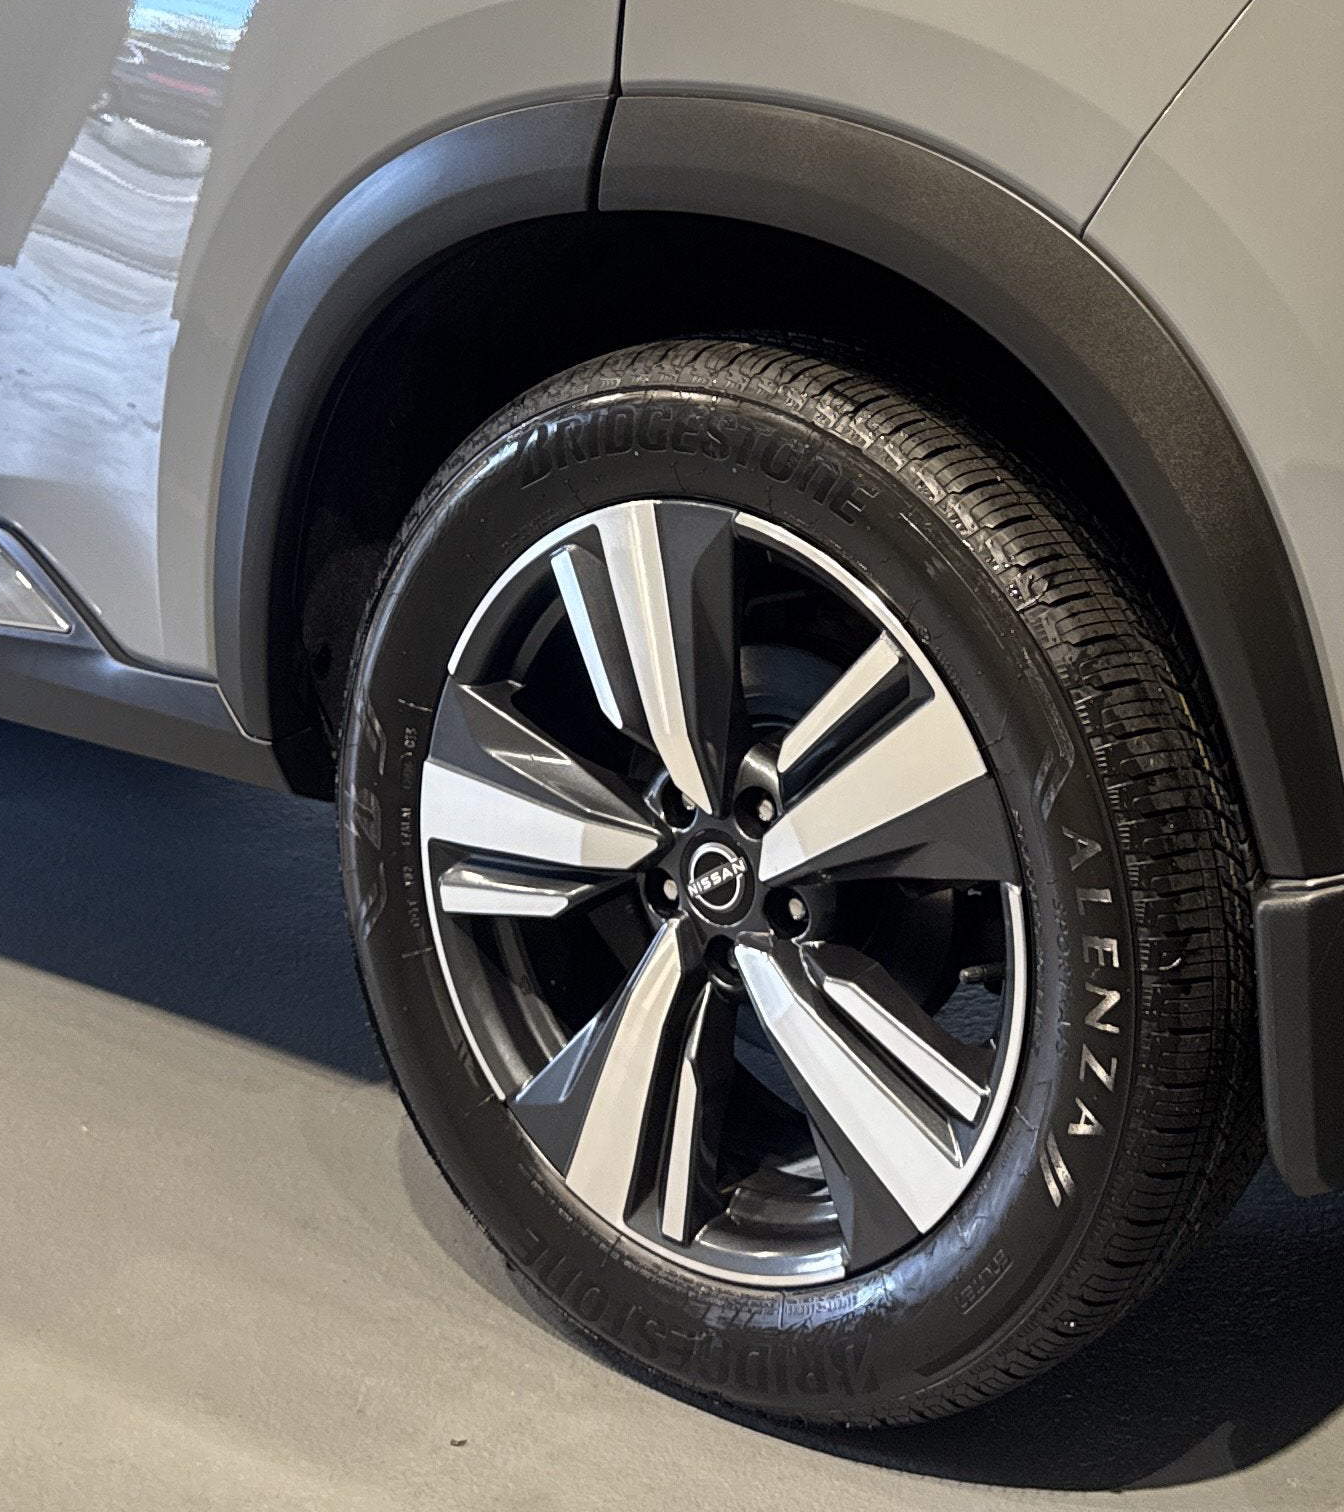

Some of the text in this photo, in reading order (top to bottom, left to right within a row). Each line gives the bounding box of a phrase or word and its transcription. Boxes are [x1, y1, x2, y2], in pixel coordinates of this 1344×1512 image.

[517, 403, 879, 526] BRIDGESTONE
[687, 858, 746, 897] NISSAN
[1061, 826, 1122, 1136] ALENZA
